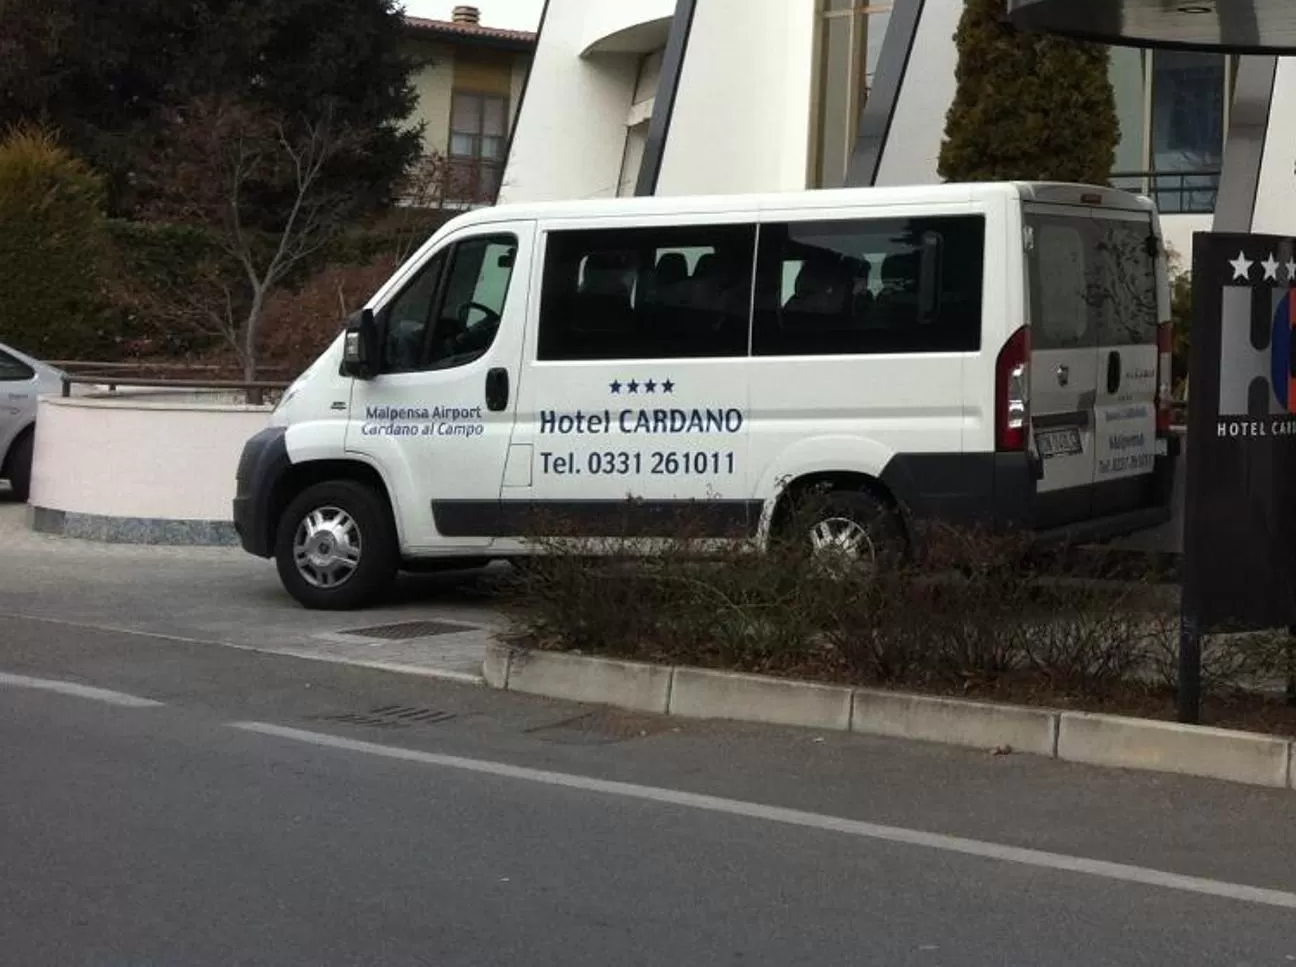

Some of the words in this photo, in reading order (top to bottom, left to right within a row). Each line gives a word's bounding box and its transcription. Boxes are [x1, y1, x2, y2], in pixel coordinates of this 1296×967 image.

[365, 406, 429, 420] Malpensa
[432, 405, 482, 421] Airport
[540, 409, 611, 433] Hotel
[618, 408, 743, 433] CARDANO
[361, 422, 419, 436] Cardano
[421, 422, 435, 436] al
[437, 422, 485, 438] Campo
[1217, 421, 1266, 437] HOTEL
[540, 452, 581, 474] Tel.
[588, 451, 642, 474] 0331
[650, 451, 735, 474] 261011
